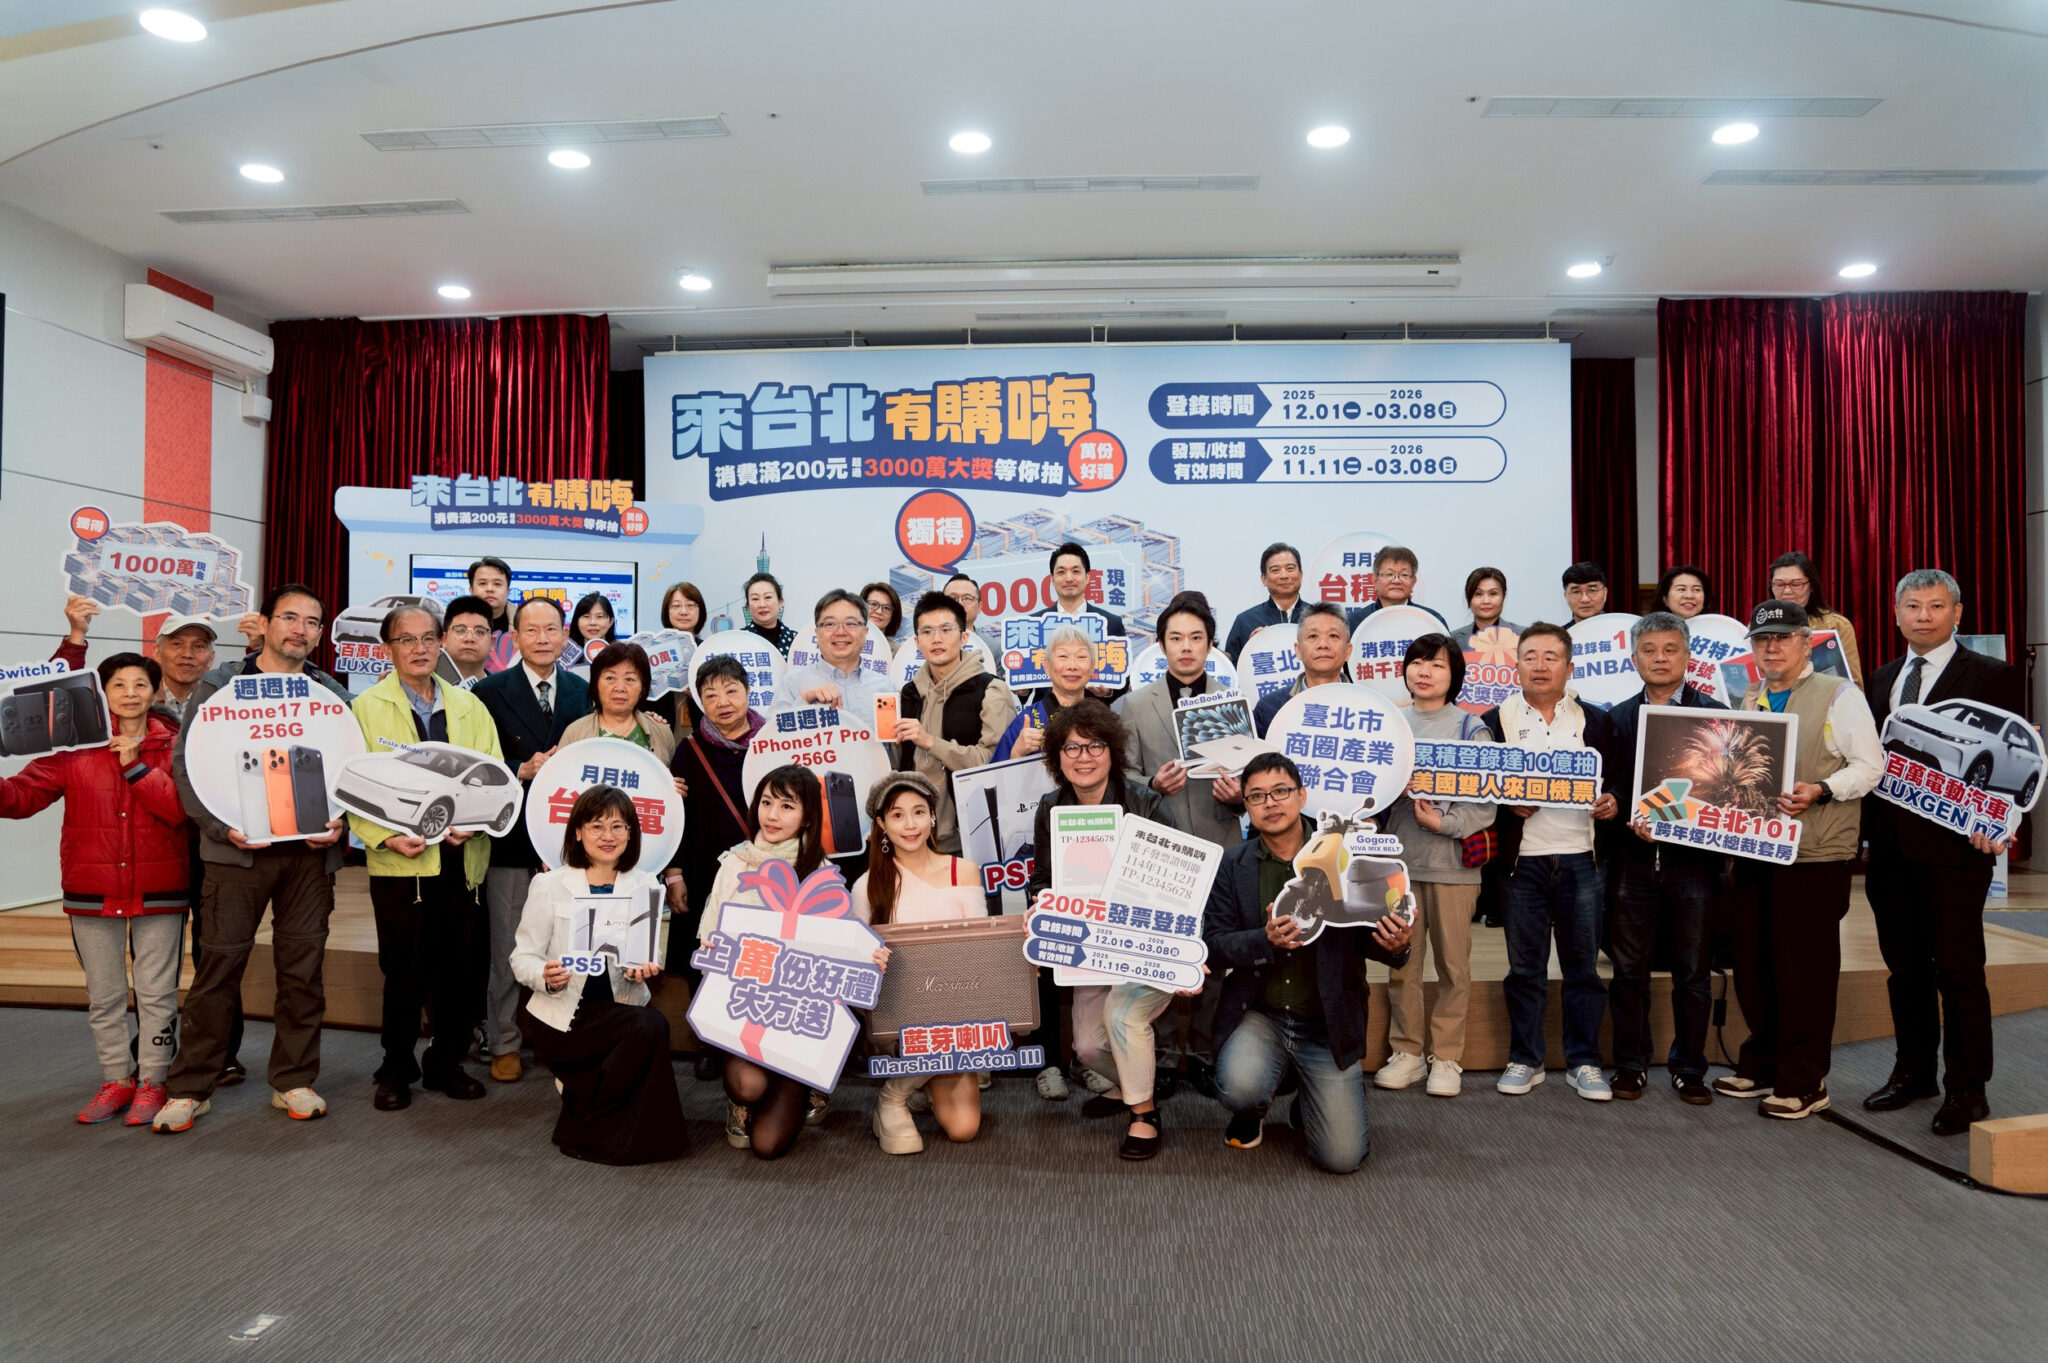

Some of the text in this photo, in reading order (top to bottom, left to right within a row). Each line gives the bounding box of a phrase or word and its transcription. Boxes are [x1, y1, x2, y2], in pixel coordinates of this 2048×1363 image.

[1166, 394, 1255, 417] 登錄時間
[1283, 389, 1423, 400] 2025 2026
[674, 375, 1093, 456] 來台北有購嗨
[1079, 442, 1114, 460] 萬份
[1171, 441, 1246, 460] 發票/收據
[1283, 444, 1423, 455] 2025 2026
[1079, 463, 1115, 480] 好禮
[1174, 462, 1244, 480] 有效時間
[411, 473, 634, 516] 來台北有購嗨
[907, 516, 964, 547] 獨得
[110, 551, 195, 578] 1000萬
[1342, 552, 1378, 567] 月月
[979, 567, 1126, 617] 000萬 現金
[1319, 573, 1379, 602] 台積
[341, 642, 385, 660] 百萬電
[0, 662, 66, 680] Switch 2
[337, 658, 394, 674] LUXGE
[234, 676, 310, 701] 週週抽
[1180, 689, 1240, 708] MacBook Air
[1457, 684, 1521, 704] 大獎等
[202, 701, 344, 722] iPhone17 Pro
[776, 707, 840, 733] 週週抽
[1301, 703, 1384, 733] 臺北市
[249, 722, 304, 740] 256G
[752, 728, 871, 755] iPhone17 Pro
[378, 737, 399, 748] Tesla
[399, 743, 423, 756] Model
[791, 749, 837, 767] 256G
[1285, 732, 1395, 766] 商圈產業
[1414, 743, 1597, 776] 累積登錄達10億抽
[581, 764, 640, 789] 月月抽
[1296, 763, 1377, 795] 聯合會
[1413, 769, 1597, 803] 美國雙人來回機票
[1886, 752, 2010, 822] 百萬電動汽車
[548, 786, 665, 835] 台電
[1876, 777, 2006, 842] LUXGEN n7
[1061, 834, 1115, 844] TP-12345678
[1356, 835, 1396, 845] Gogoro
[1654, 821, 1793, 861] 跨年煙火總裁套房
[1121, 866, 1193, 900] TP-12345678
[1125, 854, 1197, 888] 114年11-12月
[1039, 919, 1083, 938] 登錄時間
[562, 956, 602, 973] PS5
[694, 934, 879, 1006] 上萬份好禮
[916, 974, 982, 993] Marshall
[730, 983, 830, 1037] 大方送
[903, 1022, 1009, 1056] 藍芽喇叭
[871, 1049, 1042, 1076] Marshall Acton III
